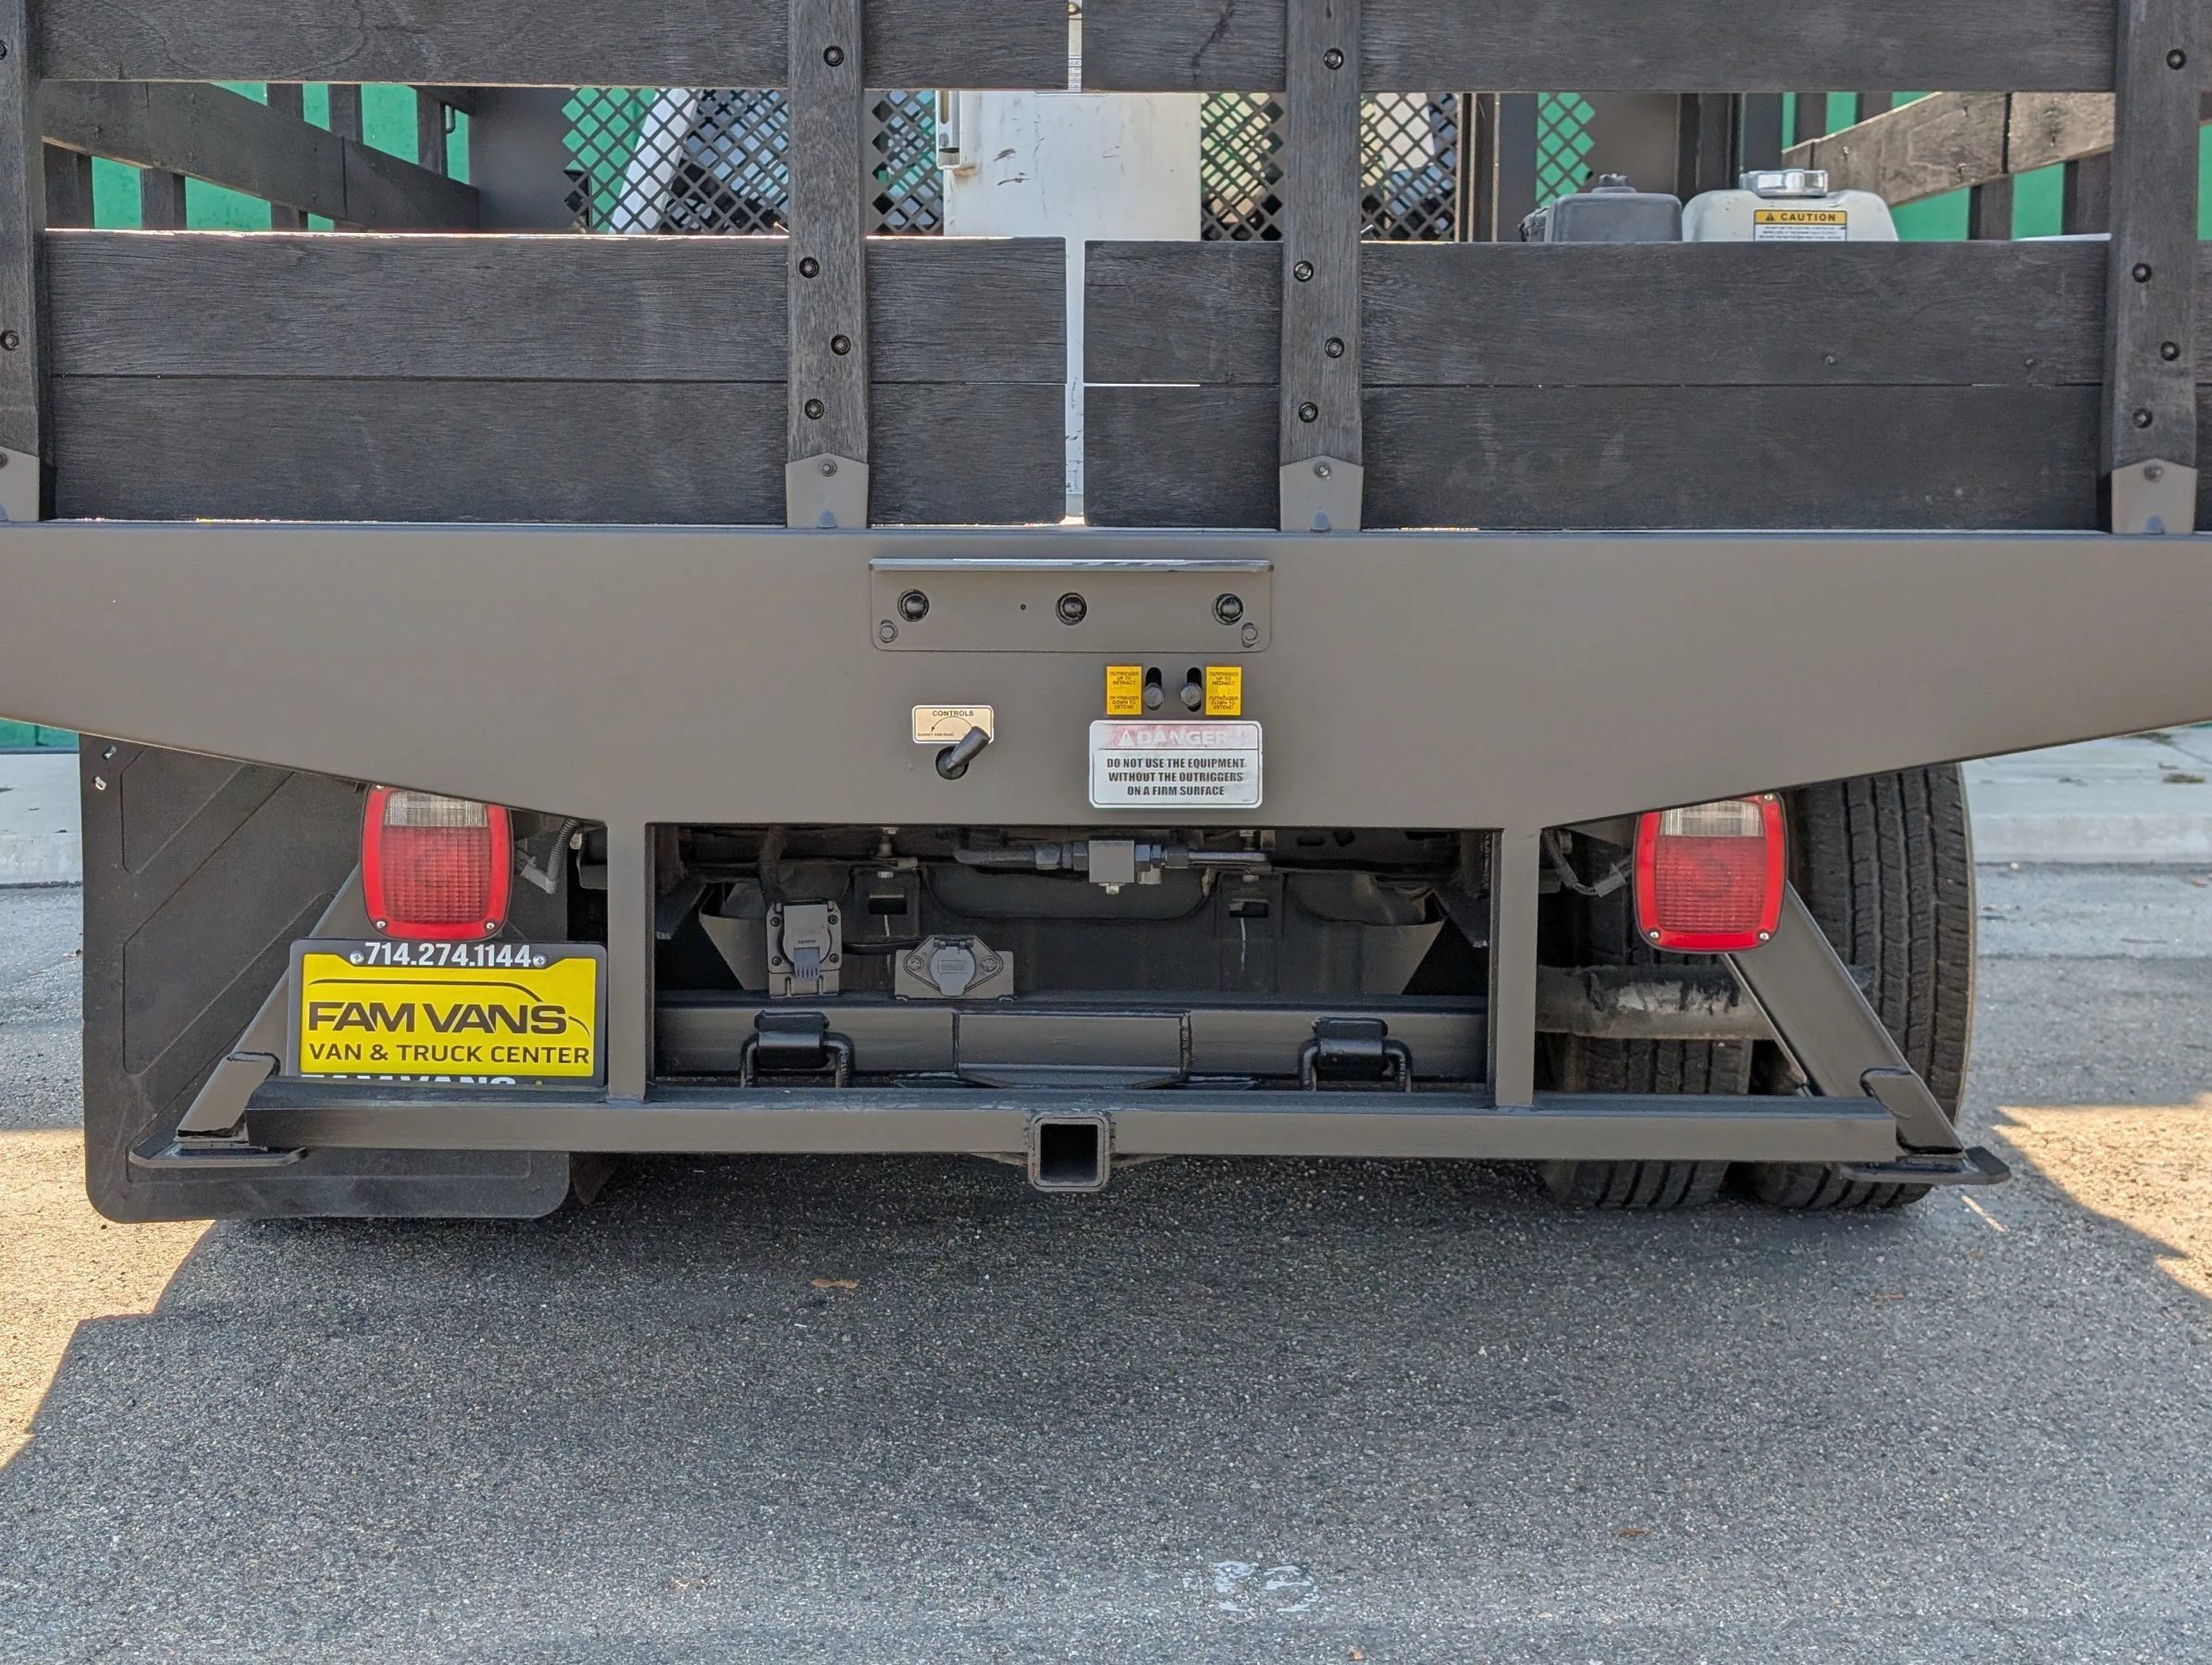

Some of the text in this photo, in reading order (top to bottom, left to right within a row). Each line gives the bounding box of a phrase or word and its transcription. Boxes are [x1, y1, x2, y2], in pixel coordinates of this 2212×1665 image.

[1780, 213, 1836, 222] CAUTION
[1137, 730, 1229, 746] DANGER
[1106, 758, 1245, 769] DO NOT USE THE EQUIPMENT
[1108, 771, 1243, 782] WITHOUT THE OUTRIGGERS
[1127, 785, 1225, 796] ON A FIRM SURFACE
[365, 942, 532, 968] 714.274.1144
[308, 1001, 568, 1035] FAM VANS
[309, 1042, 590, 1064] VAN & TRUCK CENTER
